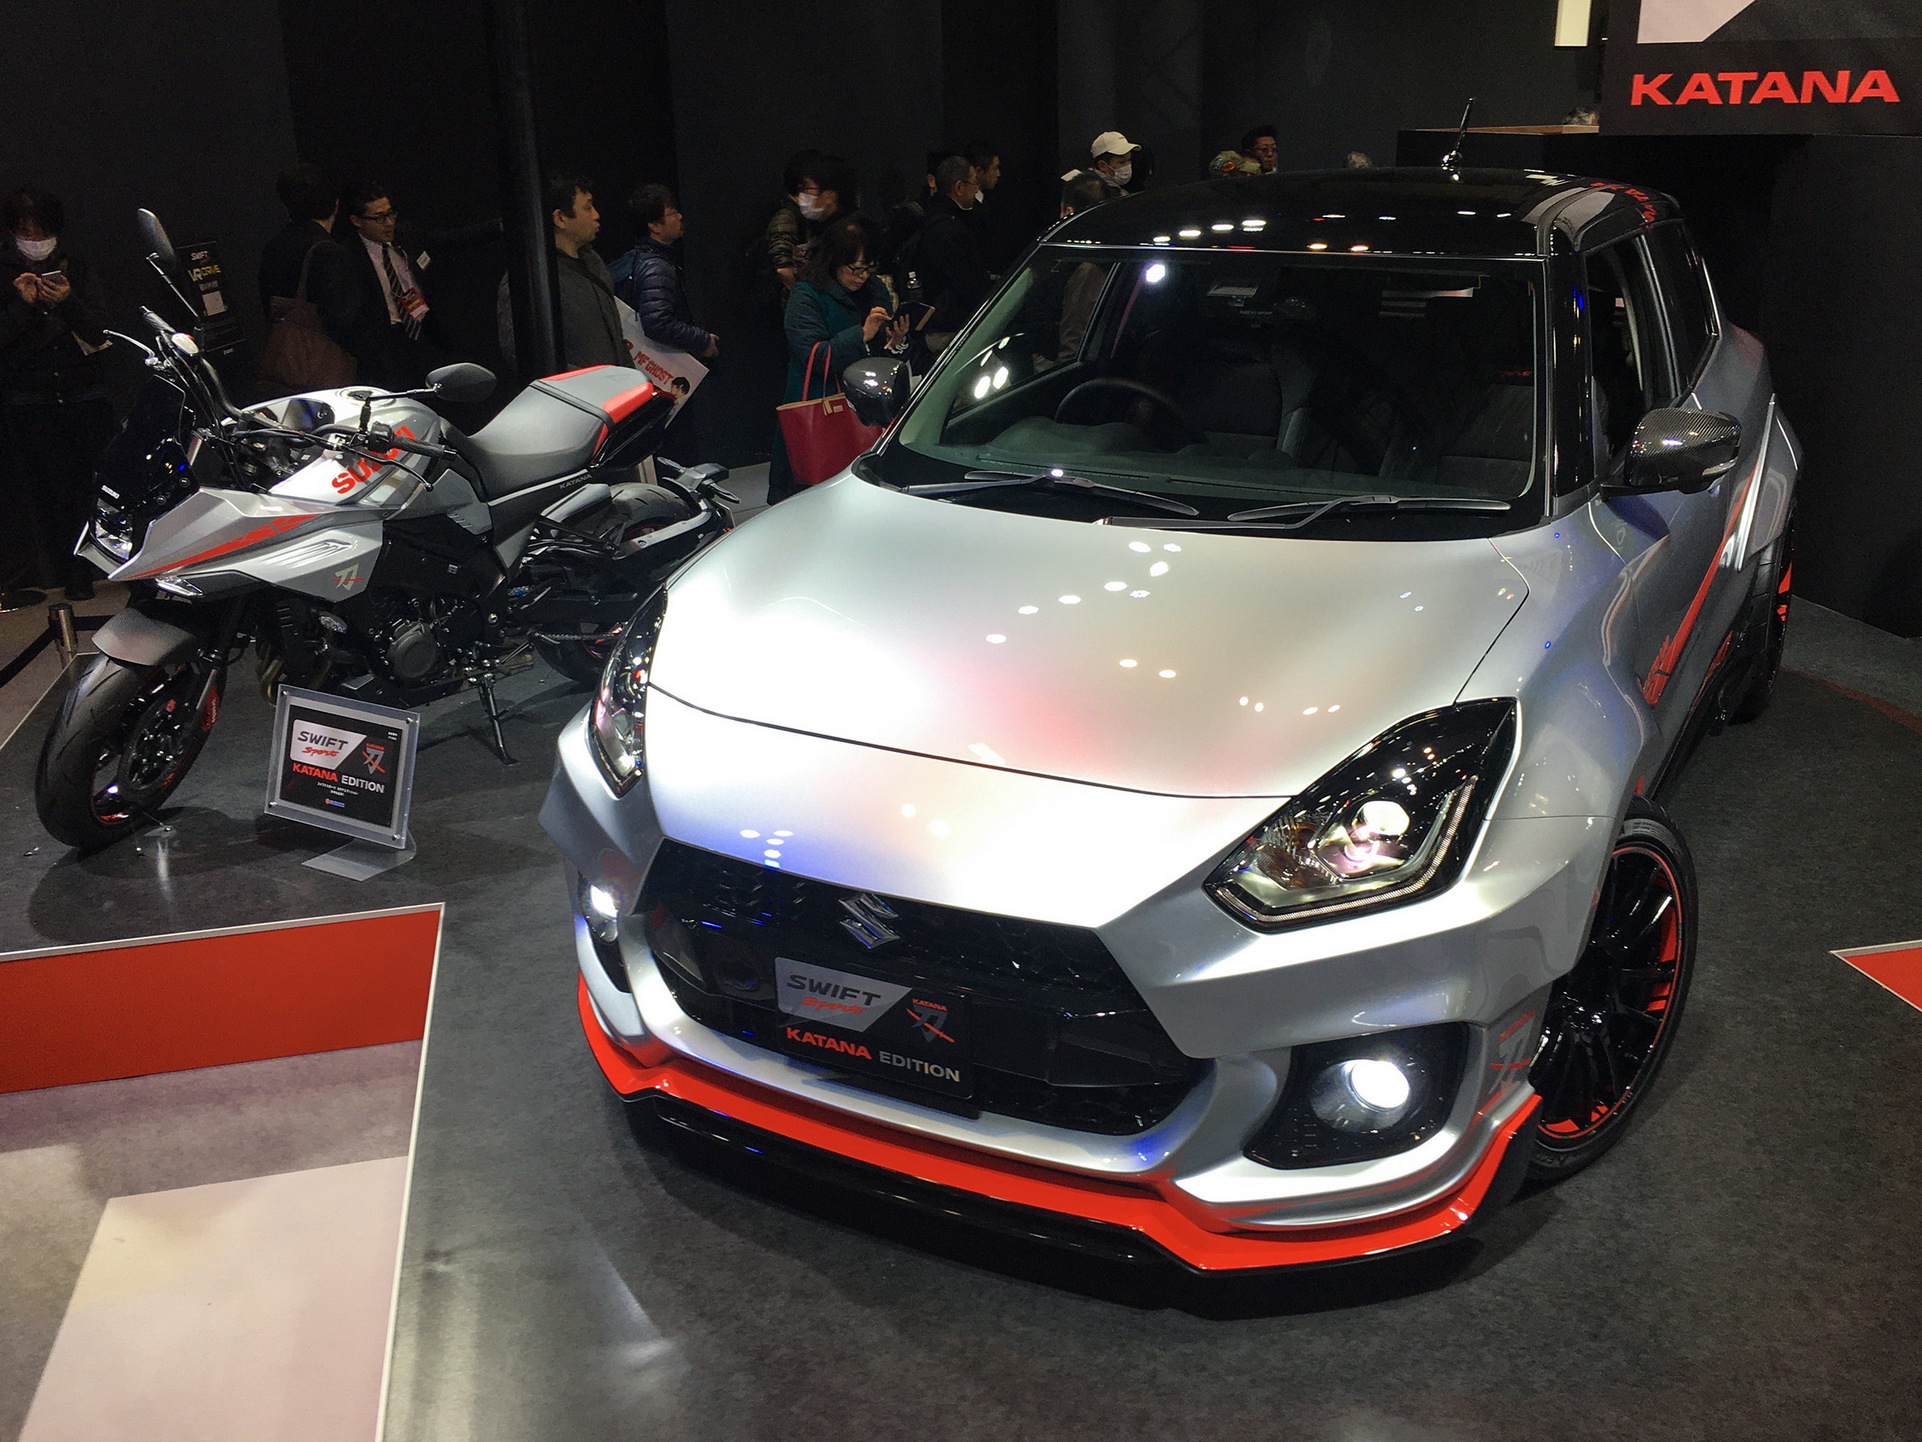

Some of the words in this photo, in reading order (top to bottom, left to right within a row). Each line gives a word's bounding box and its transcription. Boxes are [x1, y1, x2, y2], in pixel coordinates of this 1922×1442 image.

[1630, 70, 1900, 106] KATANA
[633, 351, 650, 366] MF
[645, 360, 674, 385] GHOST
[297, 730, 349, 751] SWIFT
[301, 746, 340, 757] Sport
[292, 763, 339, 782] KATANA
[341, 774, 385, 794] EDITION
[786, 973, 881, 1007] SWIFT
[911, 998, 948, 1012] KATANA
[786, 1026, 873, 1060] KATANA
[879, 1050, 961, 1083] EDITION
